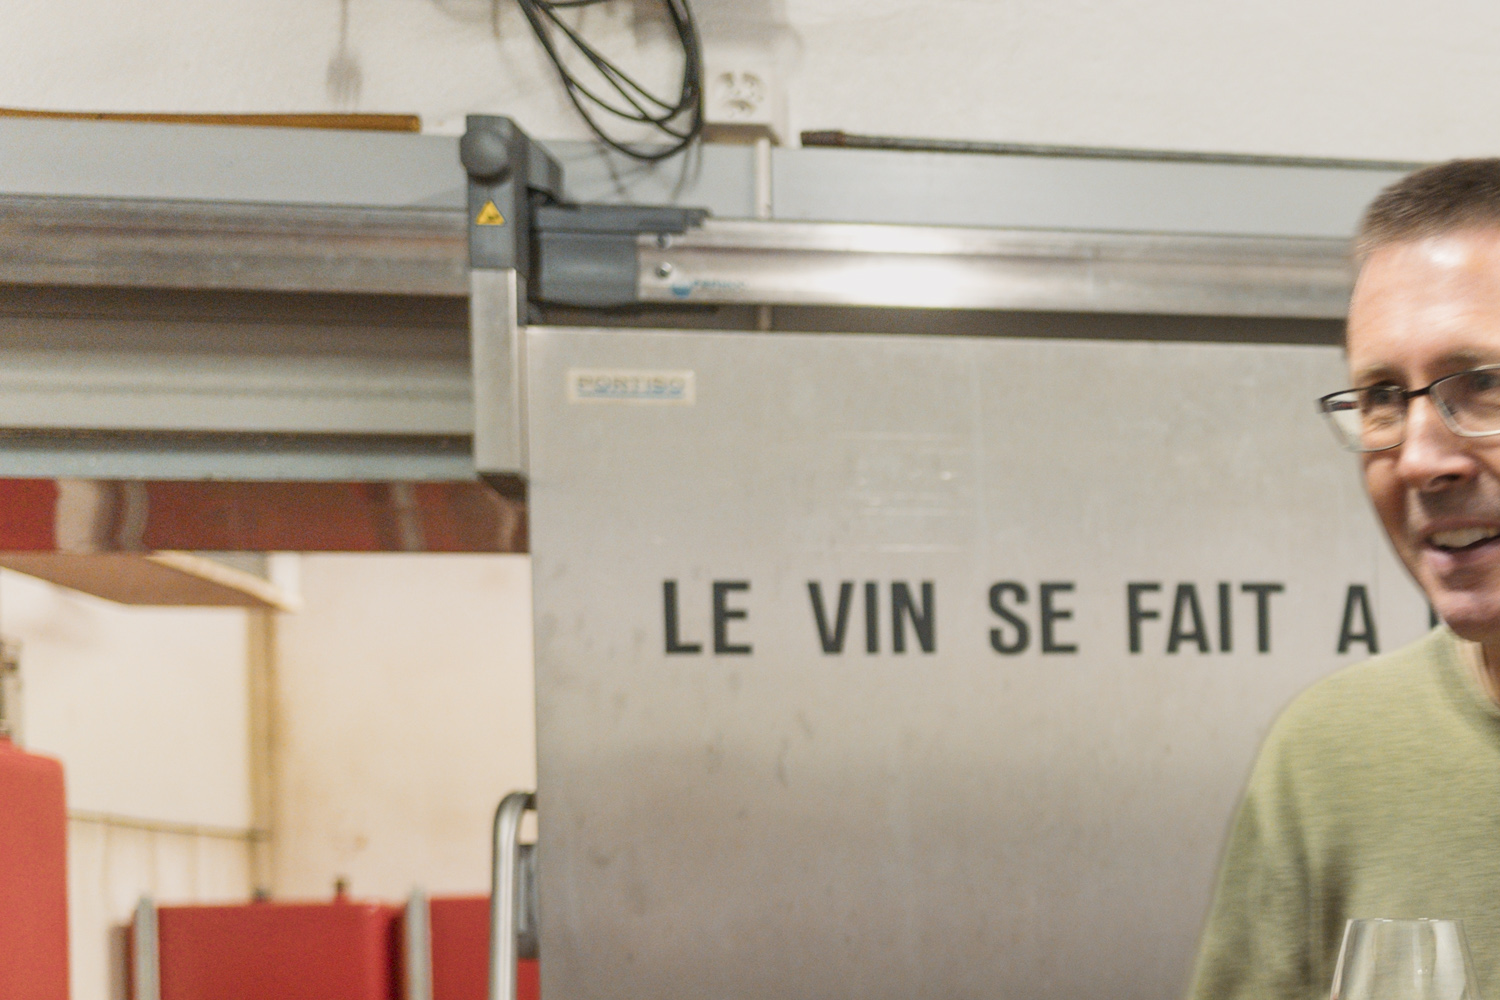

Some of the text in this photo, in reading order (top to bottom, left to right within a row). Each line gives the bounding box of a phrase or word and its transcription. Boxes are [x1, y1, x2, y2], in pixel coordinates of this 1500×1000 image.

[662, 580, 1379, 655] LE VIN SE FAIT A
